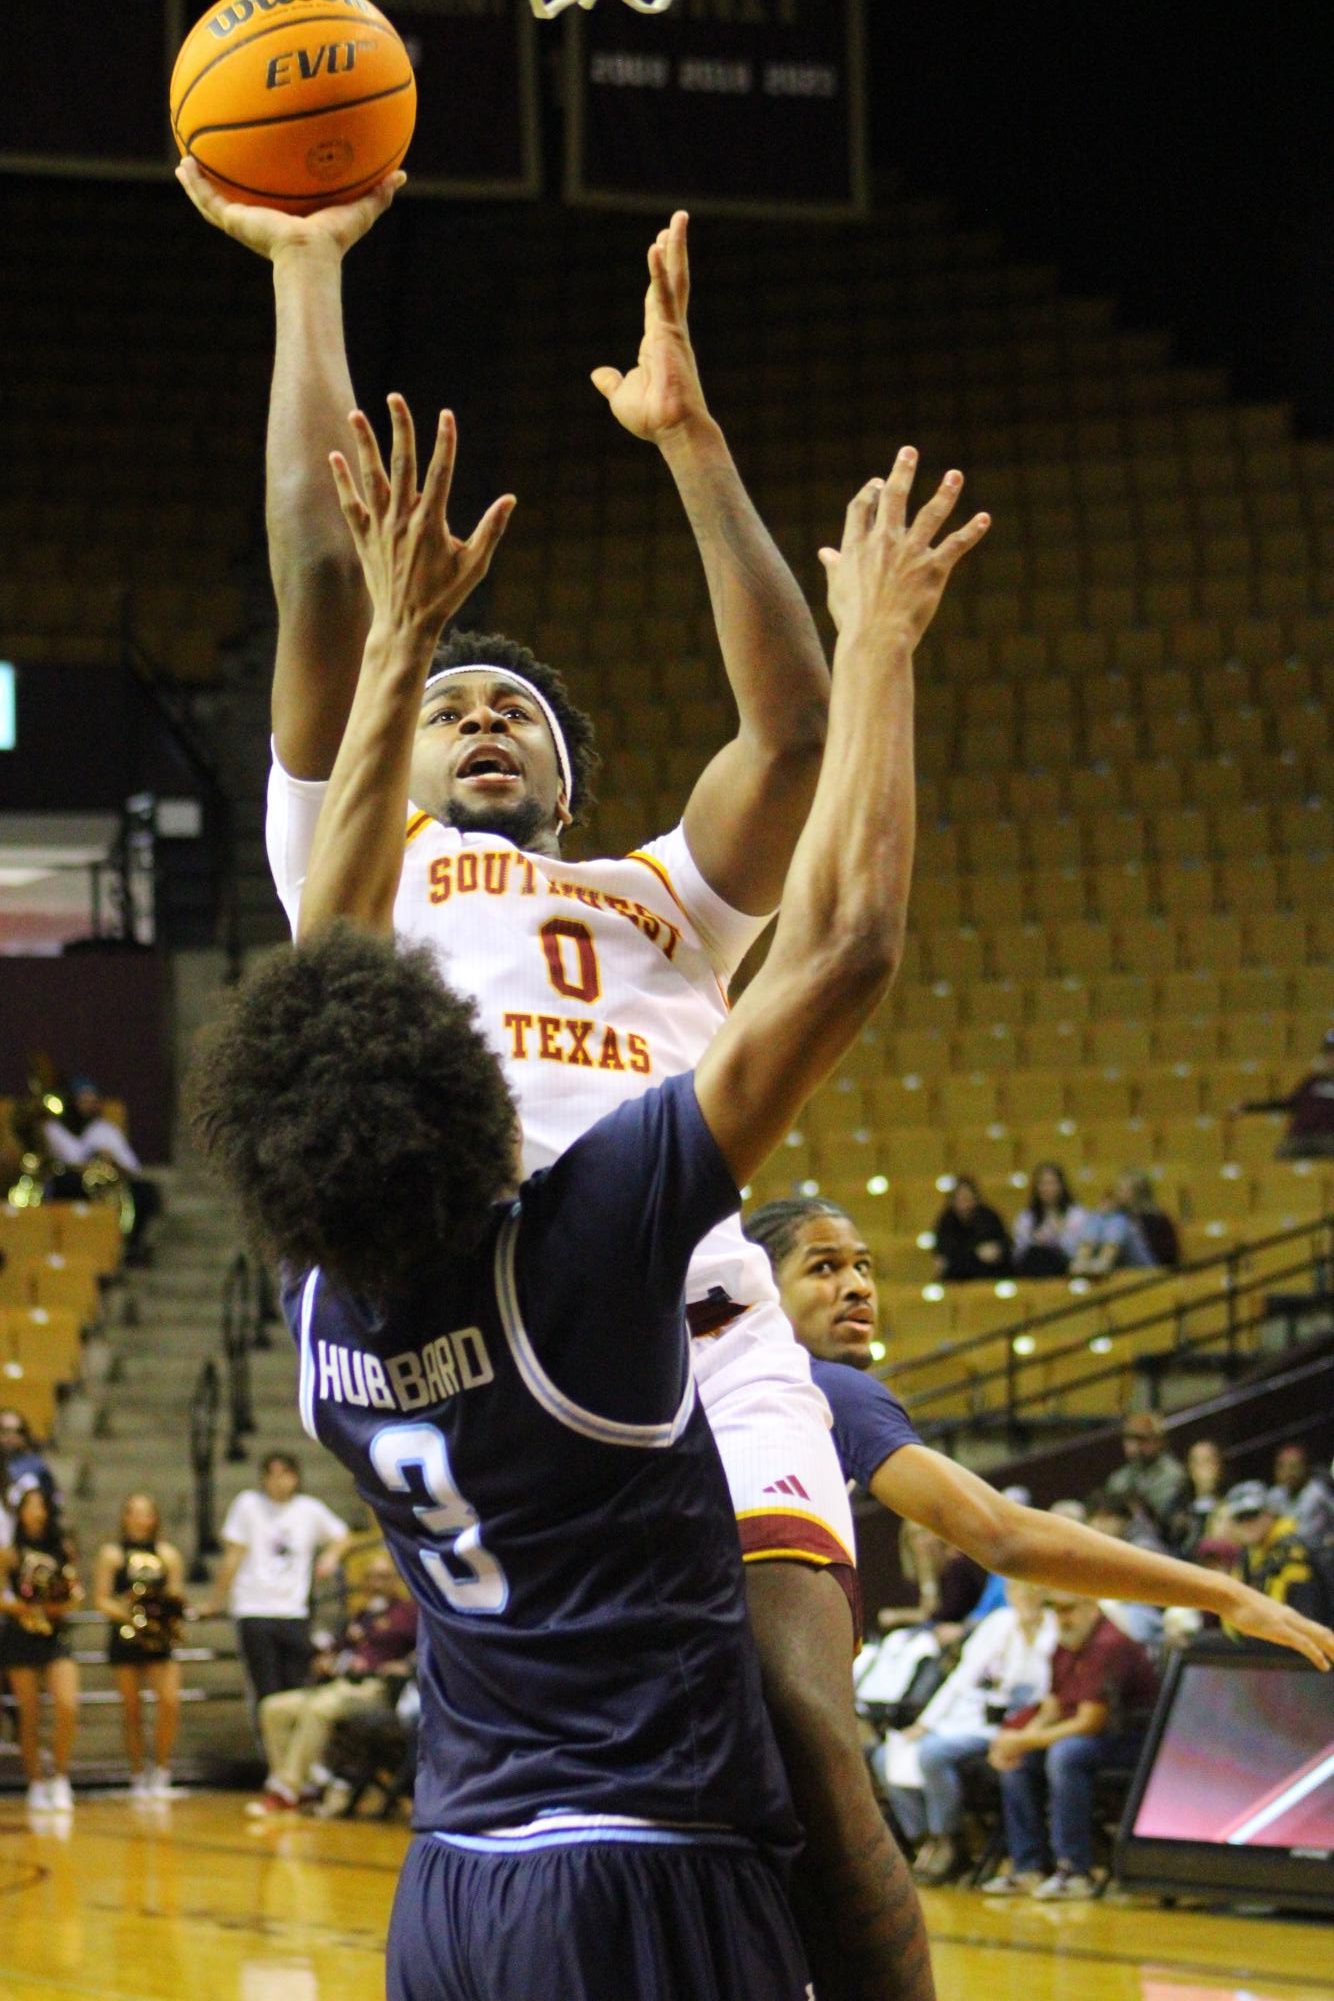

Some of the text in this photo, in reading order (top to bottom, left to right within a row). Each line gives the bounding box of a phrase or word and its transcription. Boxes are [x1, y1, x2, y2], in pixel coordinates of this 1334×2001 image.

[265, 40, 356, 90] EVO
[538, 915, 602, 1004] 0
[503, 1011, 653, 1075] TEXAS
[317, 1325, 495, 1412] HUBBARD
[368, 1421, 510, 1616] 3
